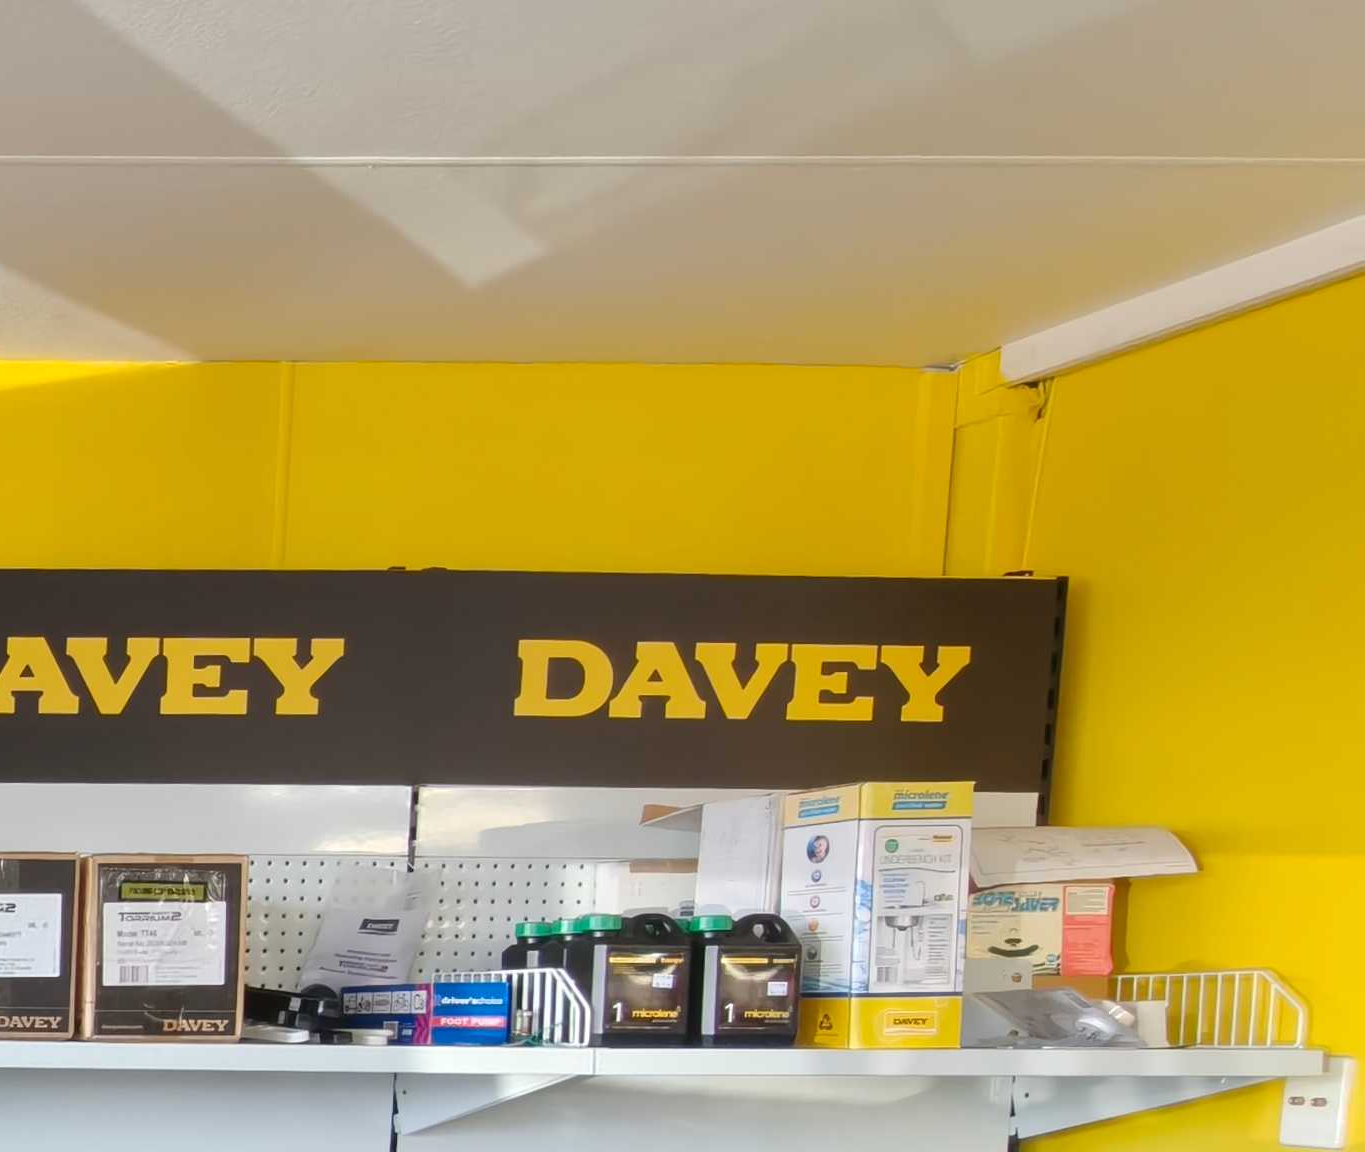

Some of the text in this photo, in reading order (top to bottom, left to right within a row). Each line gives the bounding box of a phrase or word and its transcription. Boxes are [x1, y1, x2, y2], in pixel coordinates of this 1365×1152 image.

[513, 639, 972, 722] DAVEY
[893, 790, 949, 800] microlene
[612, 1002, 623, 1022] 1
[632, 1008, 678, 1019] microlene
[724, 1003, 734, 1023] 1
[744, 1009, 790, 1019] microlene
[163, 1020, 229, 1032] DAVEY
[440, 1017, 502, 1025] FOOT PUMP
